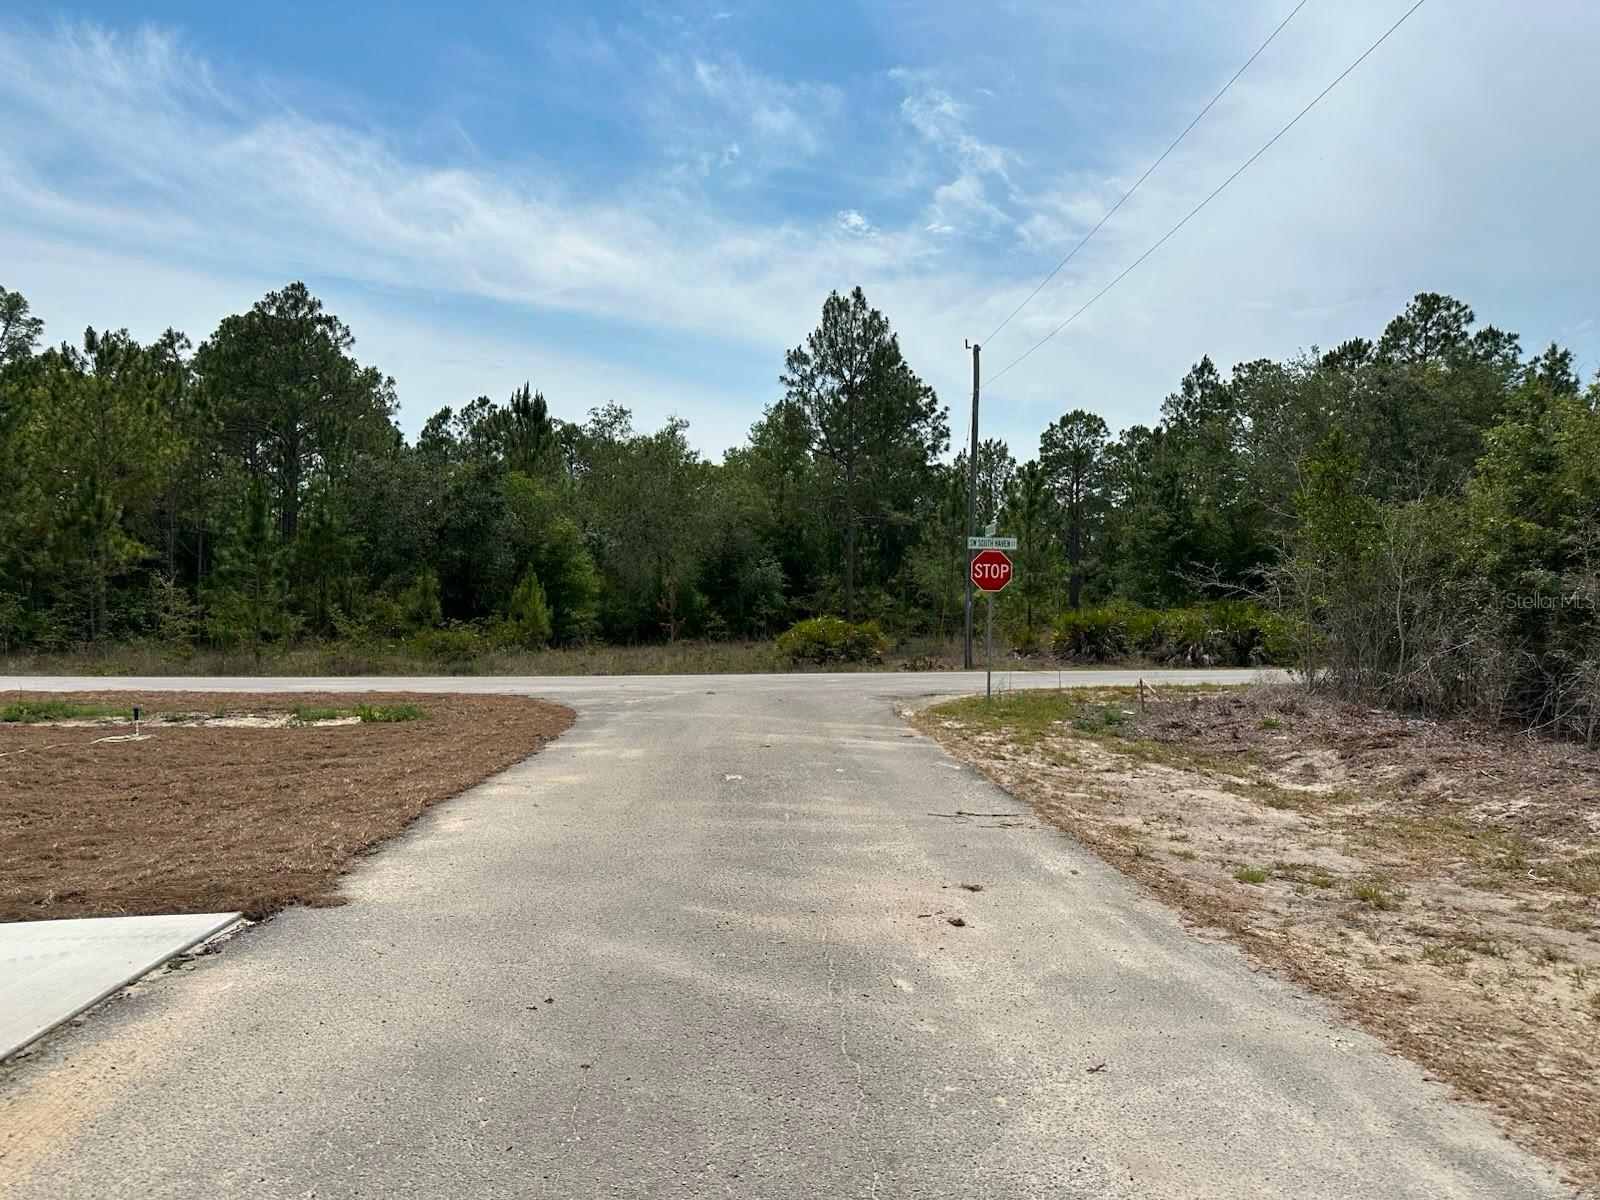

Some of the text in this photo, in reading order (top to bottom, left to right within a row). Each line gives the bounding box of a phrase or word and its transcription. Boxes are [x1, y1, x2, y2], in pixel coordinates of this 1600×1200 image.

[978, 539, 993, 547] SOUTH
[994, 539, 1010, 547] HAVEN
[974, 564, 1009, 578] STOP
